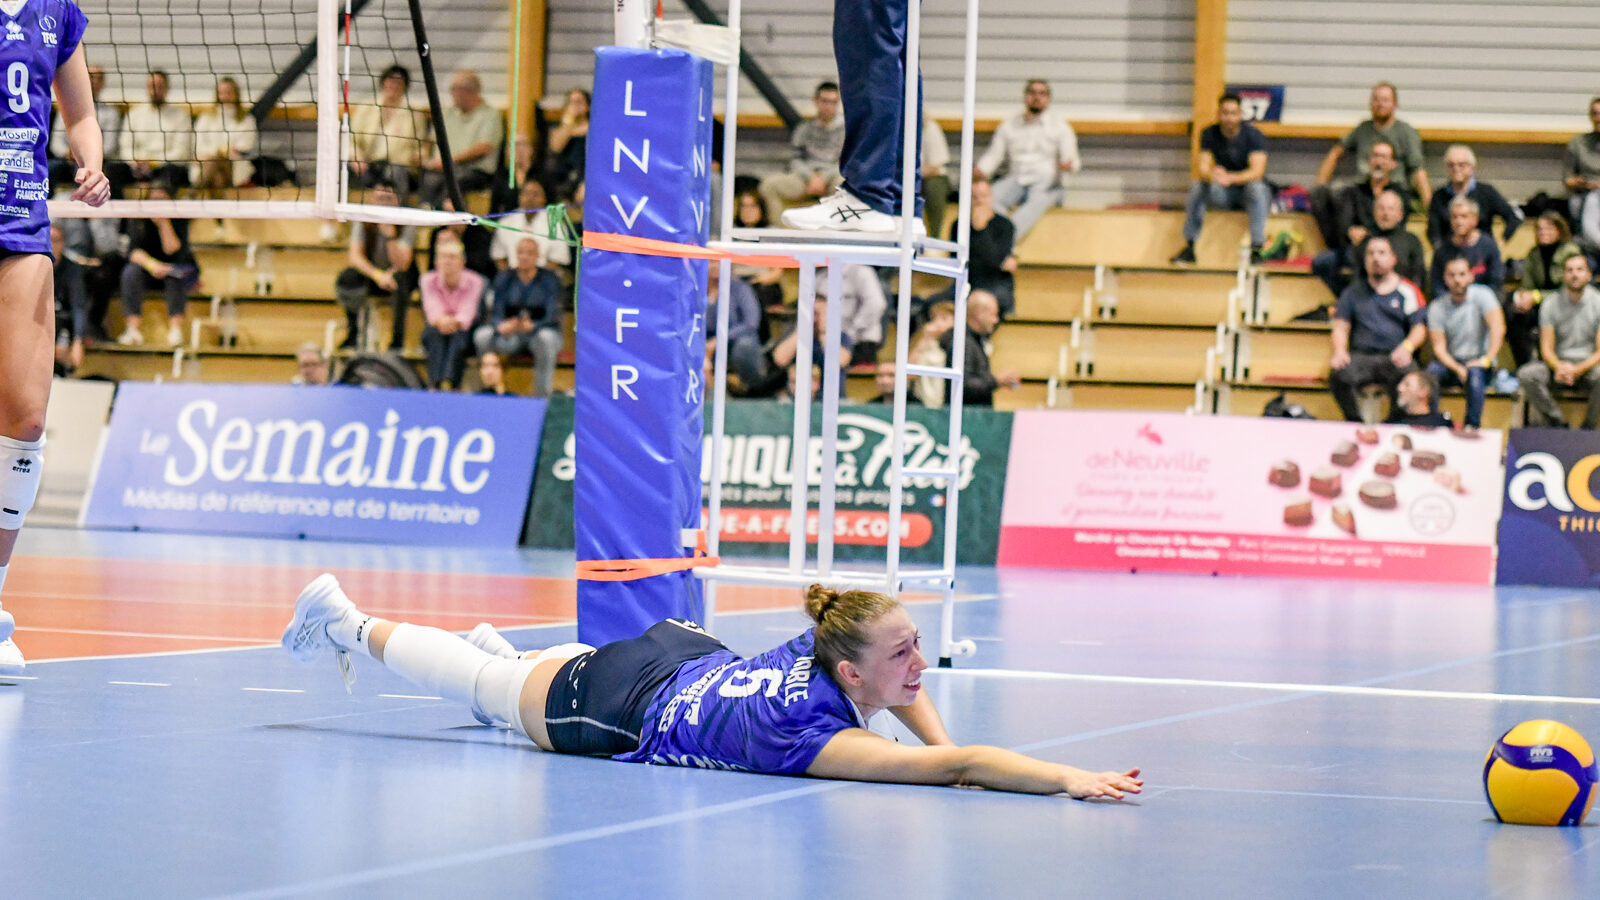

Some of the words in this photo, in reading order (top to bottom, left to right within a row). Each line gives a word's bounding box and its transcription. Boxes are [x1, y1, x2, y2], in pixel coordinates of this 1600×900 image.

[7, 62, 30, 114] 9
[0, 157, 21, 168] rand
[140, 428, 171, 457] Le
[164, 399, 496, 495] Semaine
[122, 486, 198, 512] Médias
[200, 490, 228, 513] de
[230, 491, 332, 517] référence
[333, 498, 356, 519] et
[357, 499, 387, 521] de
[388, 501, 481, 526] territoire
